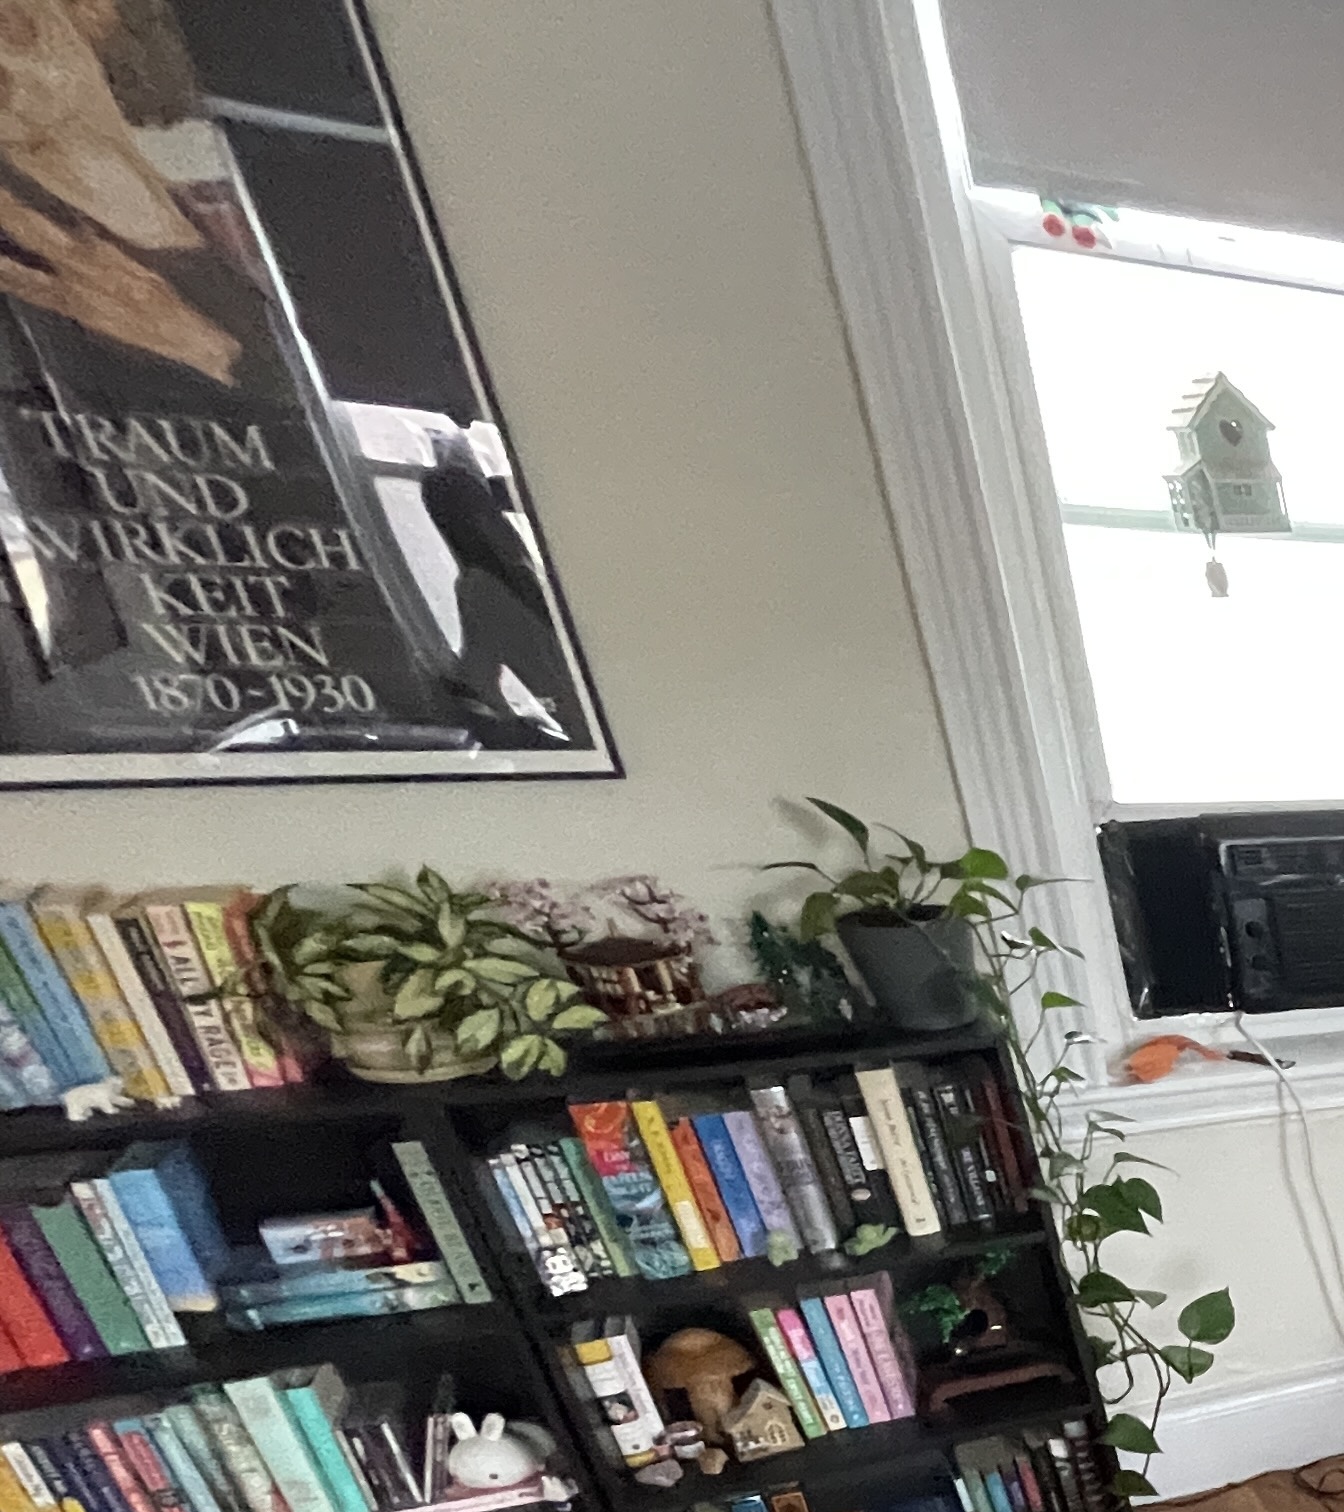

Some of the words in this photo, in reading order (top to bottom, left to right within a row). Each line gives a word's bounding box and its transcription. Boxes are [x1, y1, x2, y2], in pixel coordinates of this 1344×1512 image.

[22, 408, 276, 471] TRAUM
[95, 470, 250, 519] UND
[24, 516, 364, 572] WIRKLICH
[141, 571, 291, 619] KEIT
[141, 620, 331, 669] WIEN
